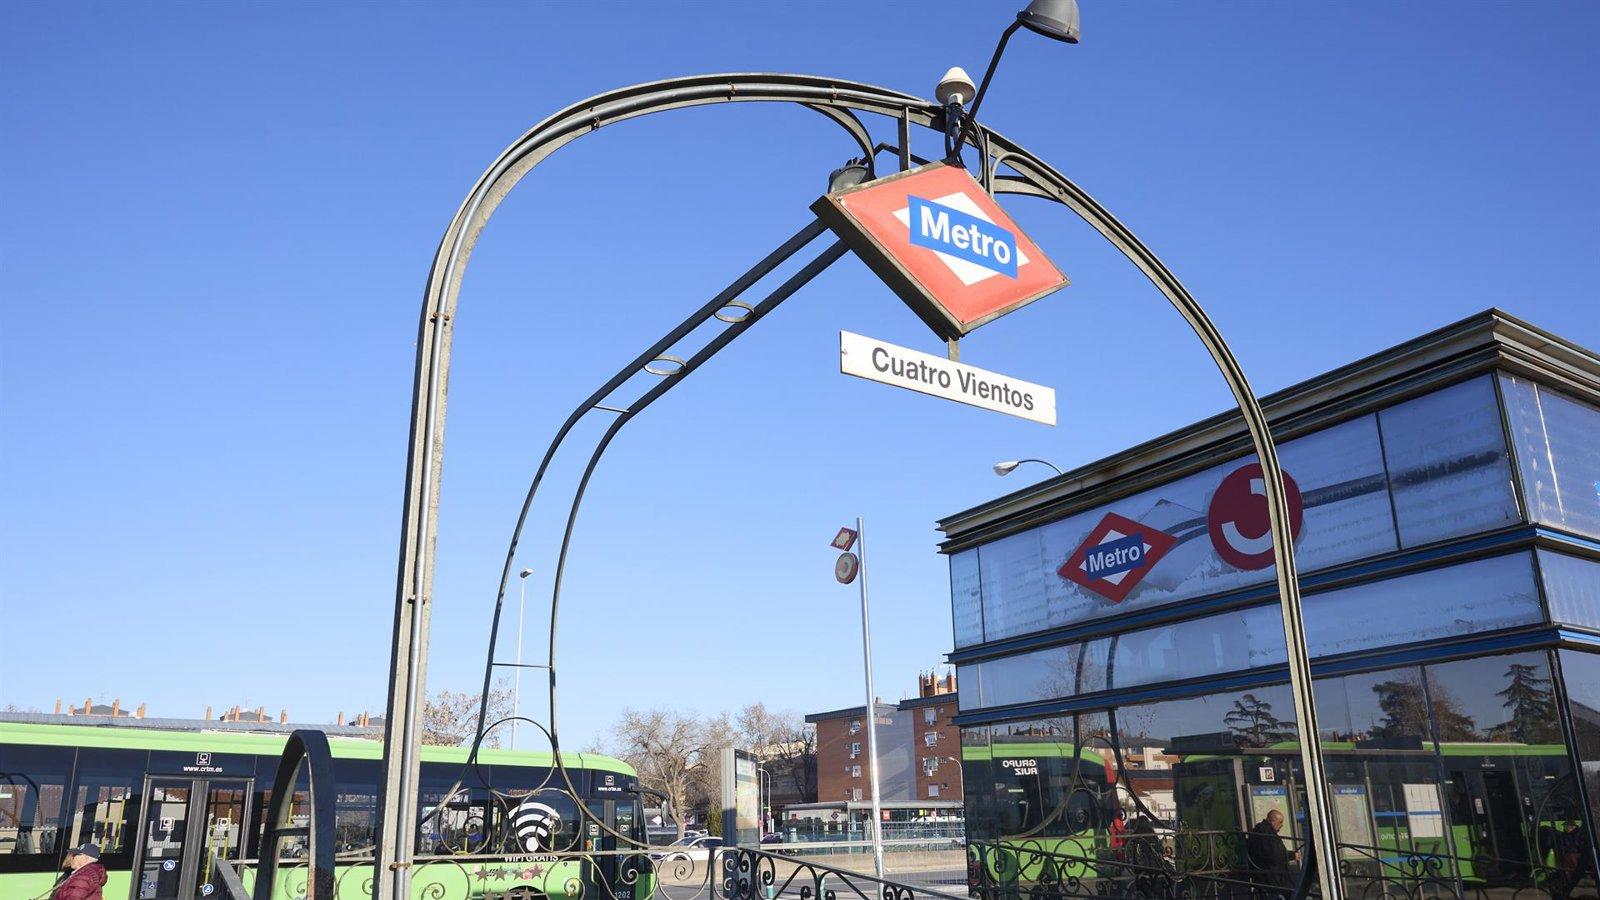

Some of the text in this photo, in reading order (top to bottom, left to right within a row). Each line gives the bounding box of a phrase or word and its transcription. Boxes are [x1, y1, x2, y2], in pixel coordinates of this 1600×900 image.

[920, 205, 1011, 265] Metro
[872, 347, 1034, 411] Cuatro Vientos
[1089, 545, 1140, 573] Metro
[614, 890, 631, 899] 1202
